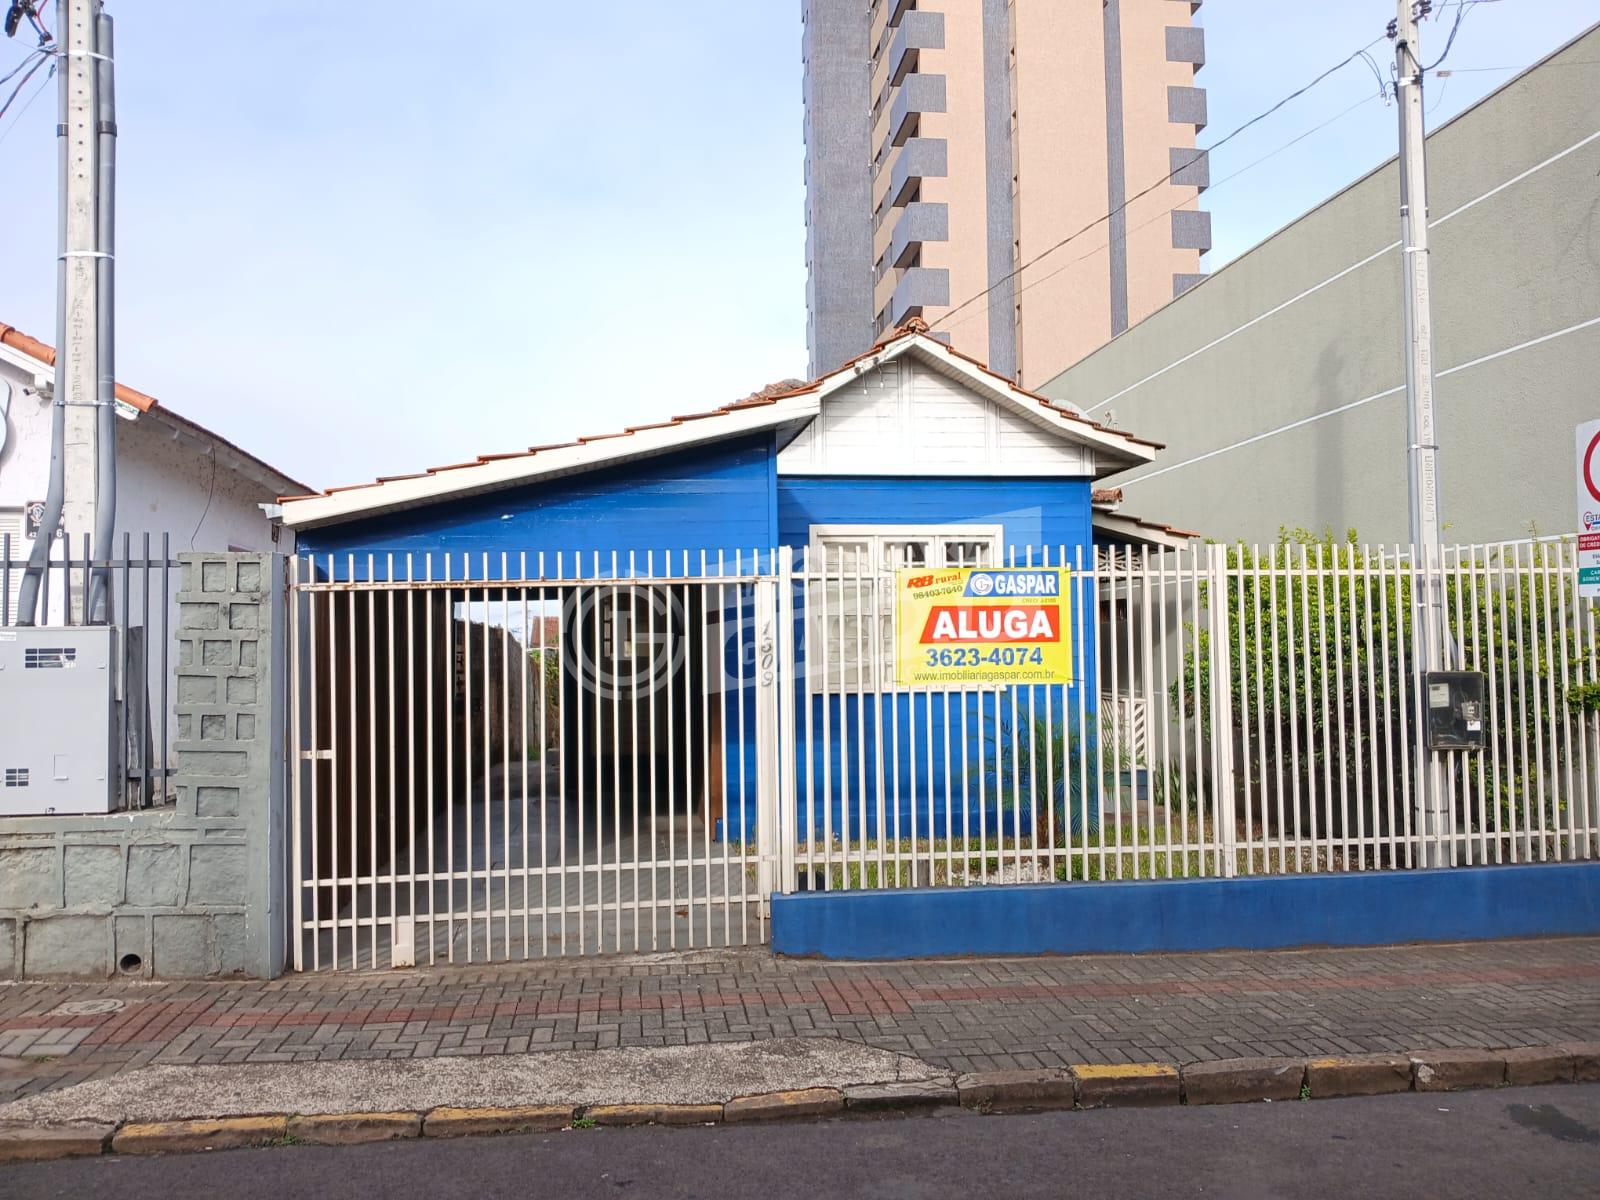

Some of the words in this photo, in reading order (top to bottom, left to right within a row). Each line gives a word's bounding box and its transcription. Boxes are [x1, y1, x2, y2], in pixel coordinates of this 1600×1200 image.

[936, 572, 961, 584] rural
[995, 574, 1056, 594] GASPAR
[932, 609, 1054, 639] ALUGA
[926, 647, 1043, 667] 3623-4074
[914, 669, 1055, 682] www.imobiliariagaspar.com.br
